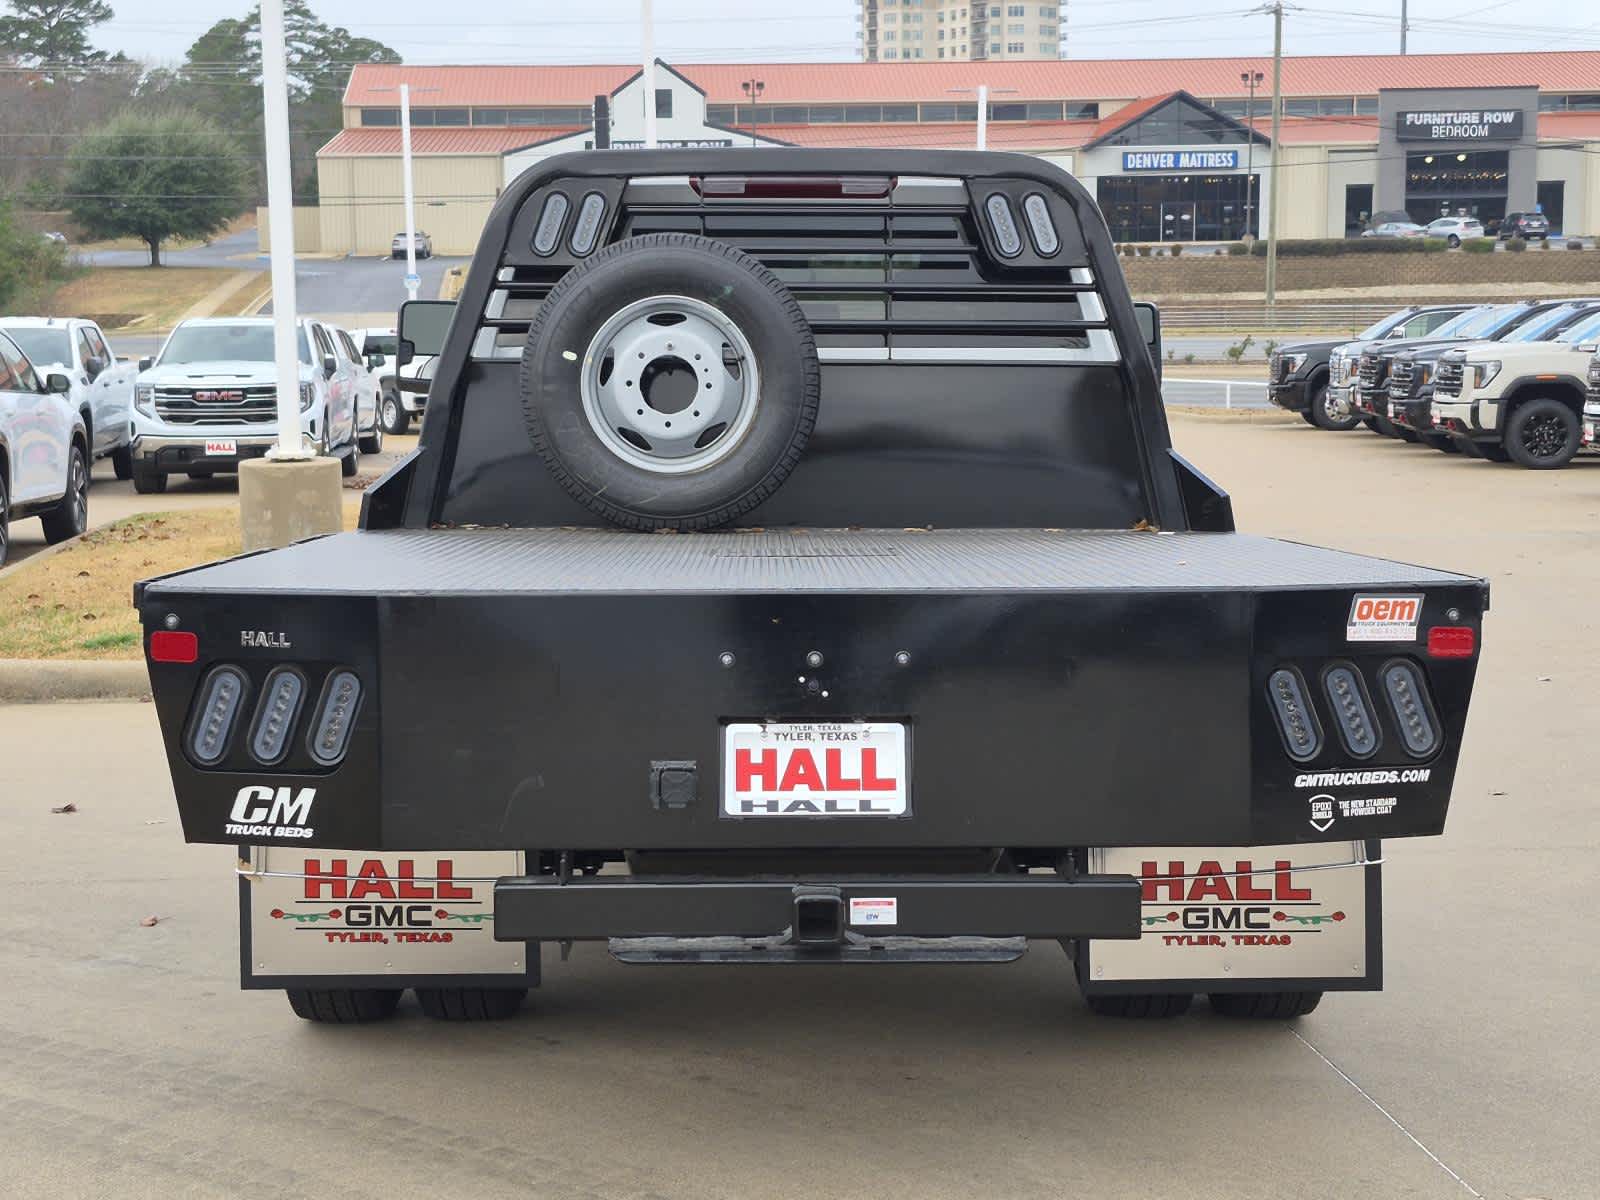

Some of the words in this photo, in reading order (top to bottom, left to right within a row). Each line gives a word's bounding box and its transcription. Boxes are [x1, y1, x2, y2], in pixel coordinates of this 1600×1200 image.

[1406, 112, 1480, 125] FURNITURE
[1483, 111, 1515, 123] ROW
[1431, 125, 1488, 137] BEDROOM
[1127, 153, 1174, 168] DENVER
[1179, 152, 1233, 168] MATTRESS
[196, 391, 243, 401] GMC
[207, 443, 235, 451] HALL
[1356, 600, 1416, 621] oem
[241, 630, 292, 648] HALL
[774, 732, 816, 742] TYLER,
[819, 732, 858, 741] TEXAS
[736, 748, 896, 792] HALL
[1294, 769, 1431, 787] CMTRUCKBEDS.COM
[230, 785, 317, 825] CM
[740, 799, 891, 812] HALL
[1338, 801, 1350, 809] THE
[1350, 799, 1365, 809] NEW
[1366, 797, 1397, 807] STANDARD
[1343, 808, 1350, 817] IN
[1351, 806, 1376, 816] POWDER
[1377, 805, 1393, 815] COAT
[225, 824, 273, 836] TRUCK
[273, 826, 314, 838] BEDS
[304, 859, 473, 899] HALL
[1141, 860, 1312, 901] HALL
[345, 905, 433, 927] GMC
[1182, 907, 1271, 929] GMC
[325, 932, 389, 944] TYLER,
[394, 932, 453, 943] TEXAS
[1162, 935, 1227, 947] TYLER,
[1232, 935, 1292, 946] TEXAS
